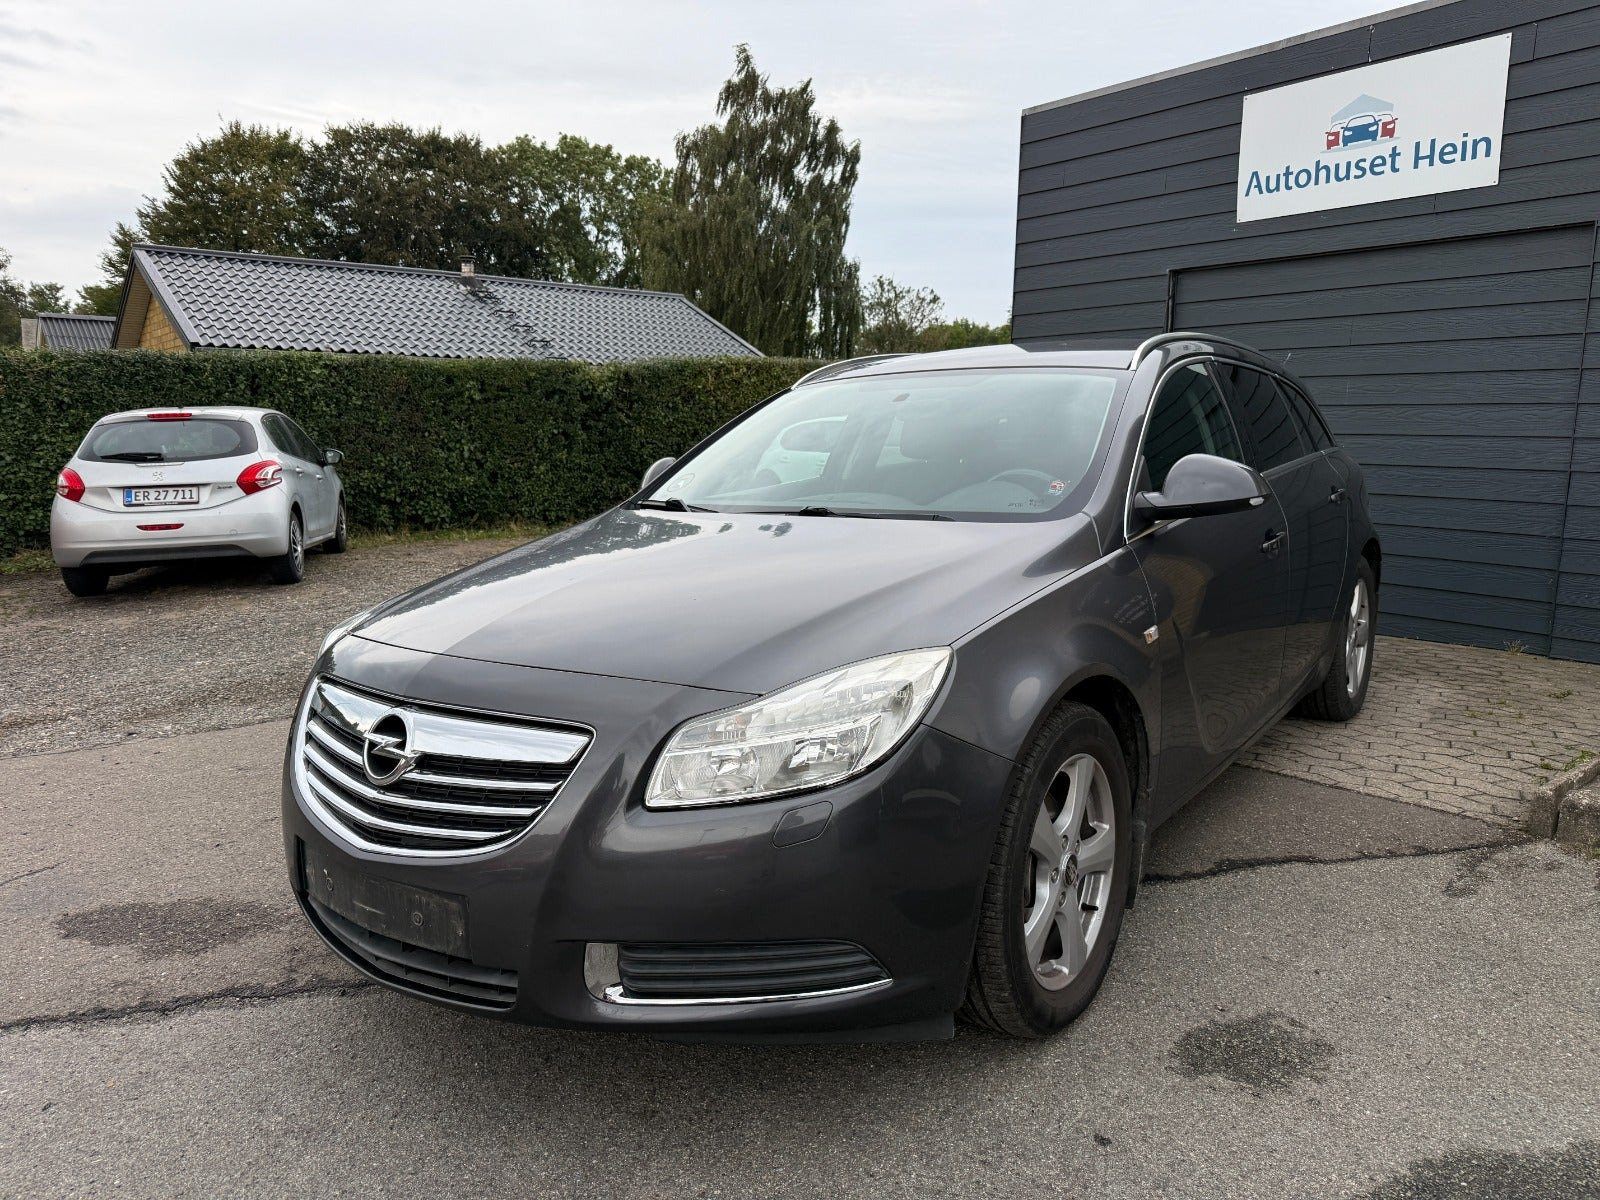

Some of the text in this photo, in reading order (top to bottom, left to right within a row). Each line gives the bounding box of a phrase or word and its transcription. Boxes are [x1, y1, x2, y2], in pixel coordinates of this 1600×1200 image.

[1245, 132, 1492, 197] Autohuset Hein
[134, 490, 151, 502] ER
